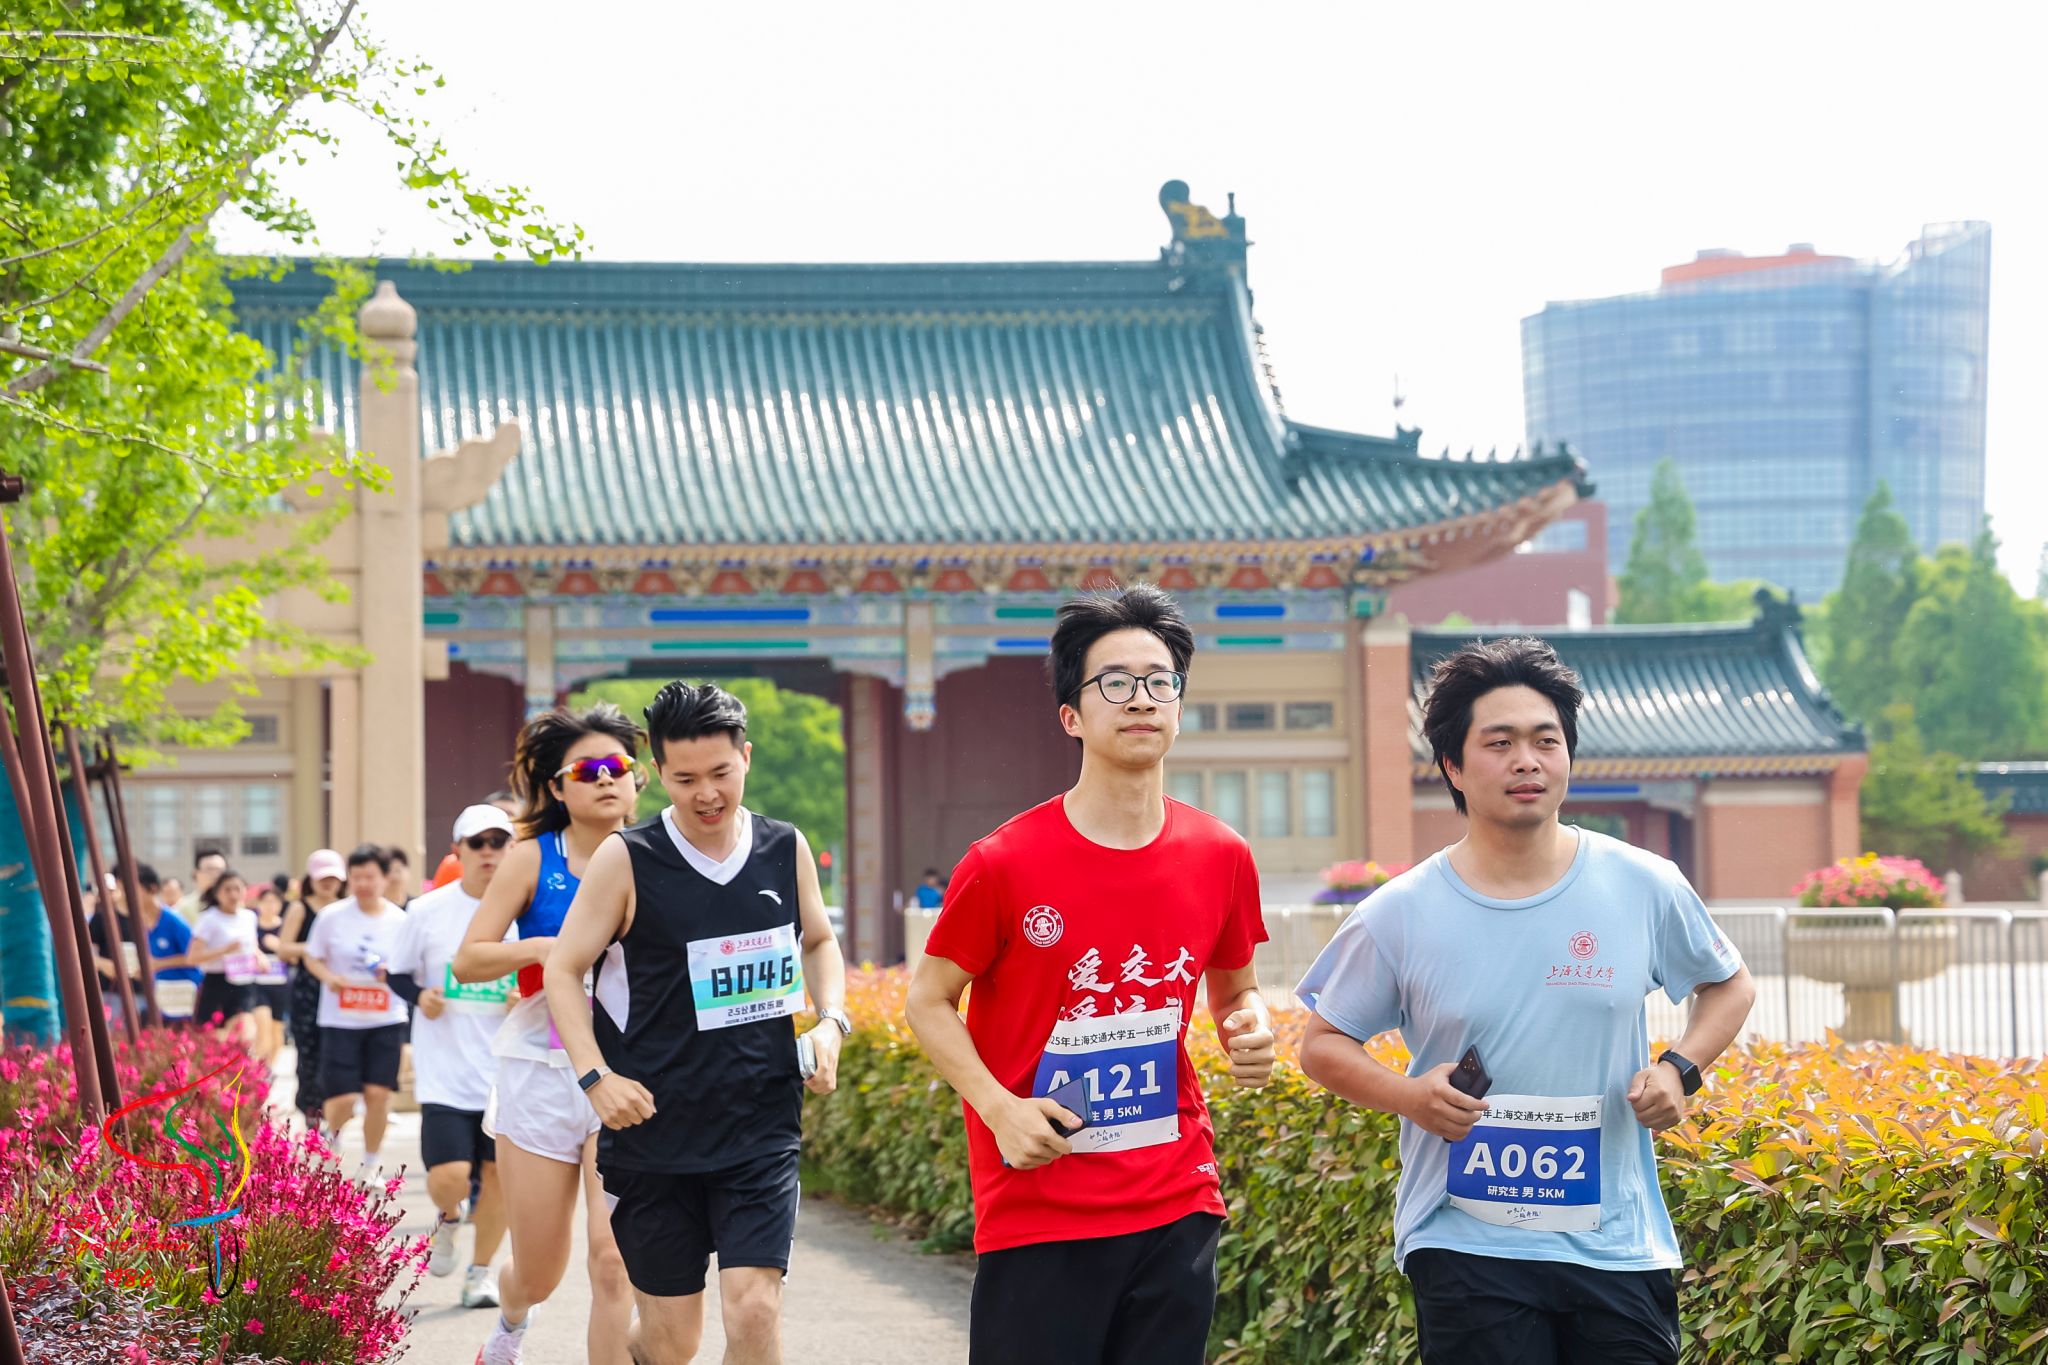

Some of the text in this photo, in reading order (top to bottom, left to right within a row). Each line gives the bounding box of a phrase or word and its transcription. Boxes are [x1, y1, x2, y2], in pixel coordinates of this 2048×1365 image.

[711, 955, 793, 998] B046
[1067, 943, 1196, 993] 爱交大
[1049, 1023, 1171, 1047] 25年上海交通大学五一长跑节
[1103, 1109, 1114, 1121] 男
[1117, 1105, 1142, 1118] 5KM
[1482, 1109, 1597, 1123] 年上海交通大学五一长跑节
[1463, 1142, 1586, 1180] A062
[1487, 1185, 1565, 1199] 研究生 男 5KM
